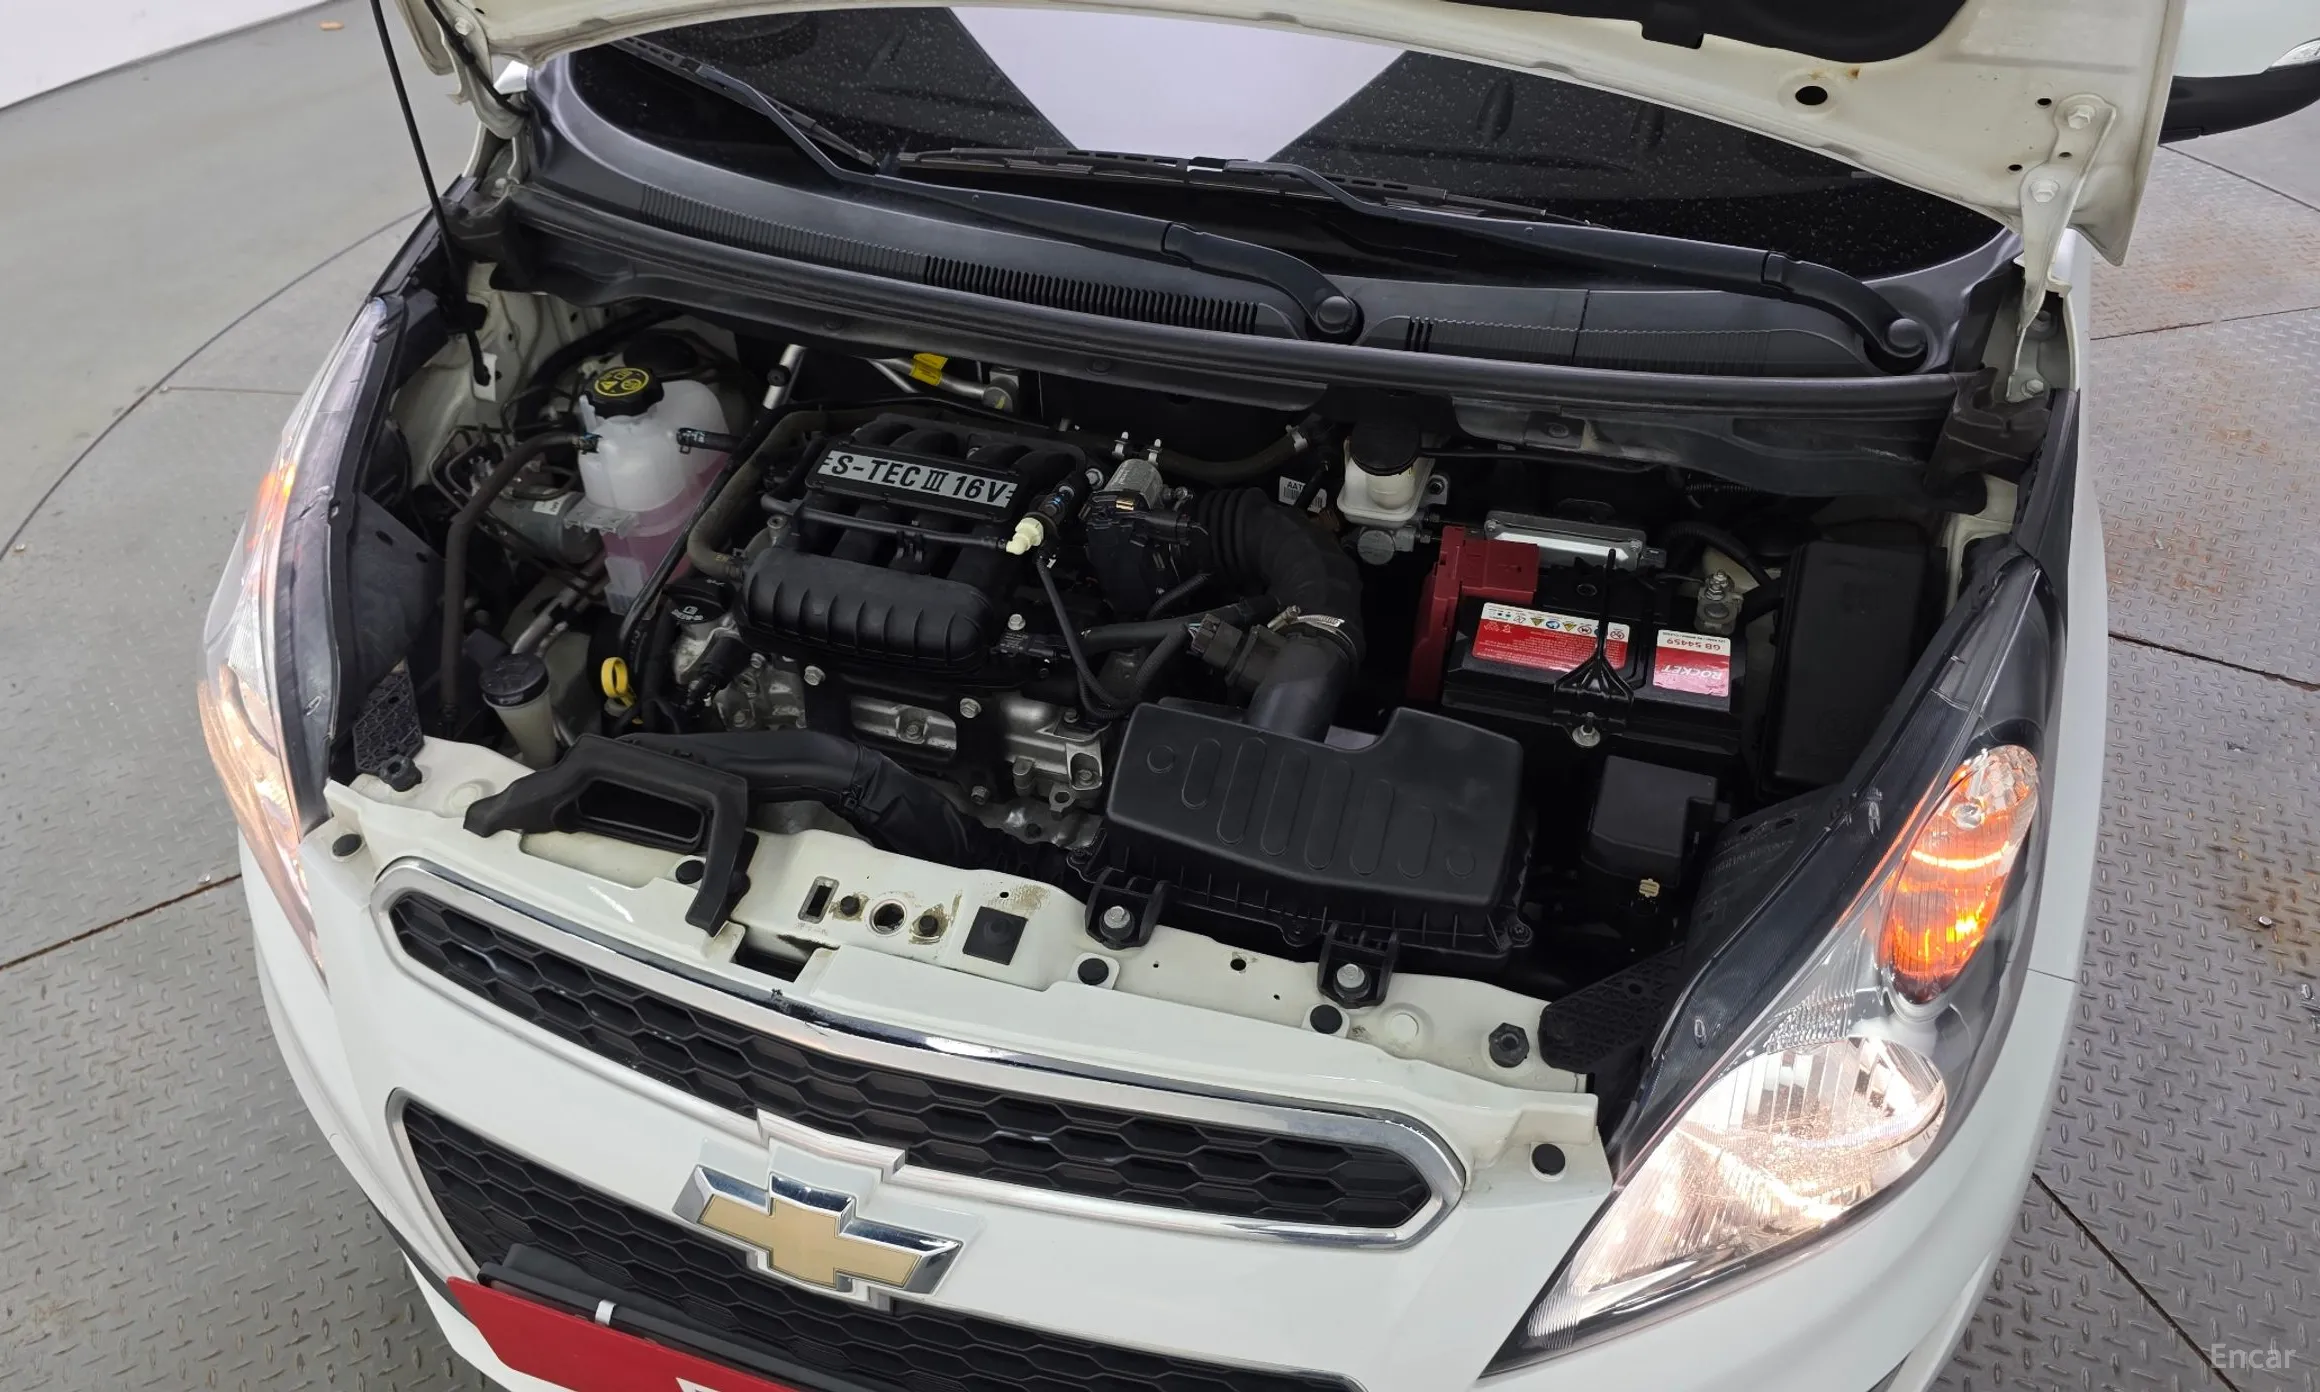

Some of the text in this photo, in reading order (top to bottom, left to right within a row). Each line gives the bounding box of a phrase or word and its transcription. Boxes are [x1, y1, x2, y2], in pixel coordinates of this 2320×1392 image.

[831, 455, 921, 487] S-TEC
[952, 475, 1008, 503] 16V
[1661, 664, 1722, 680] ROCKET
